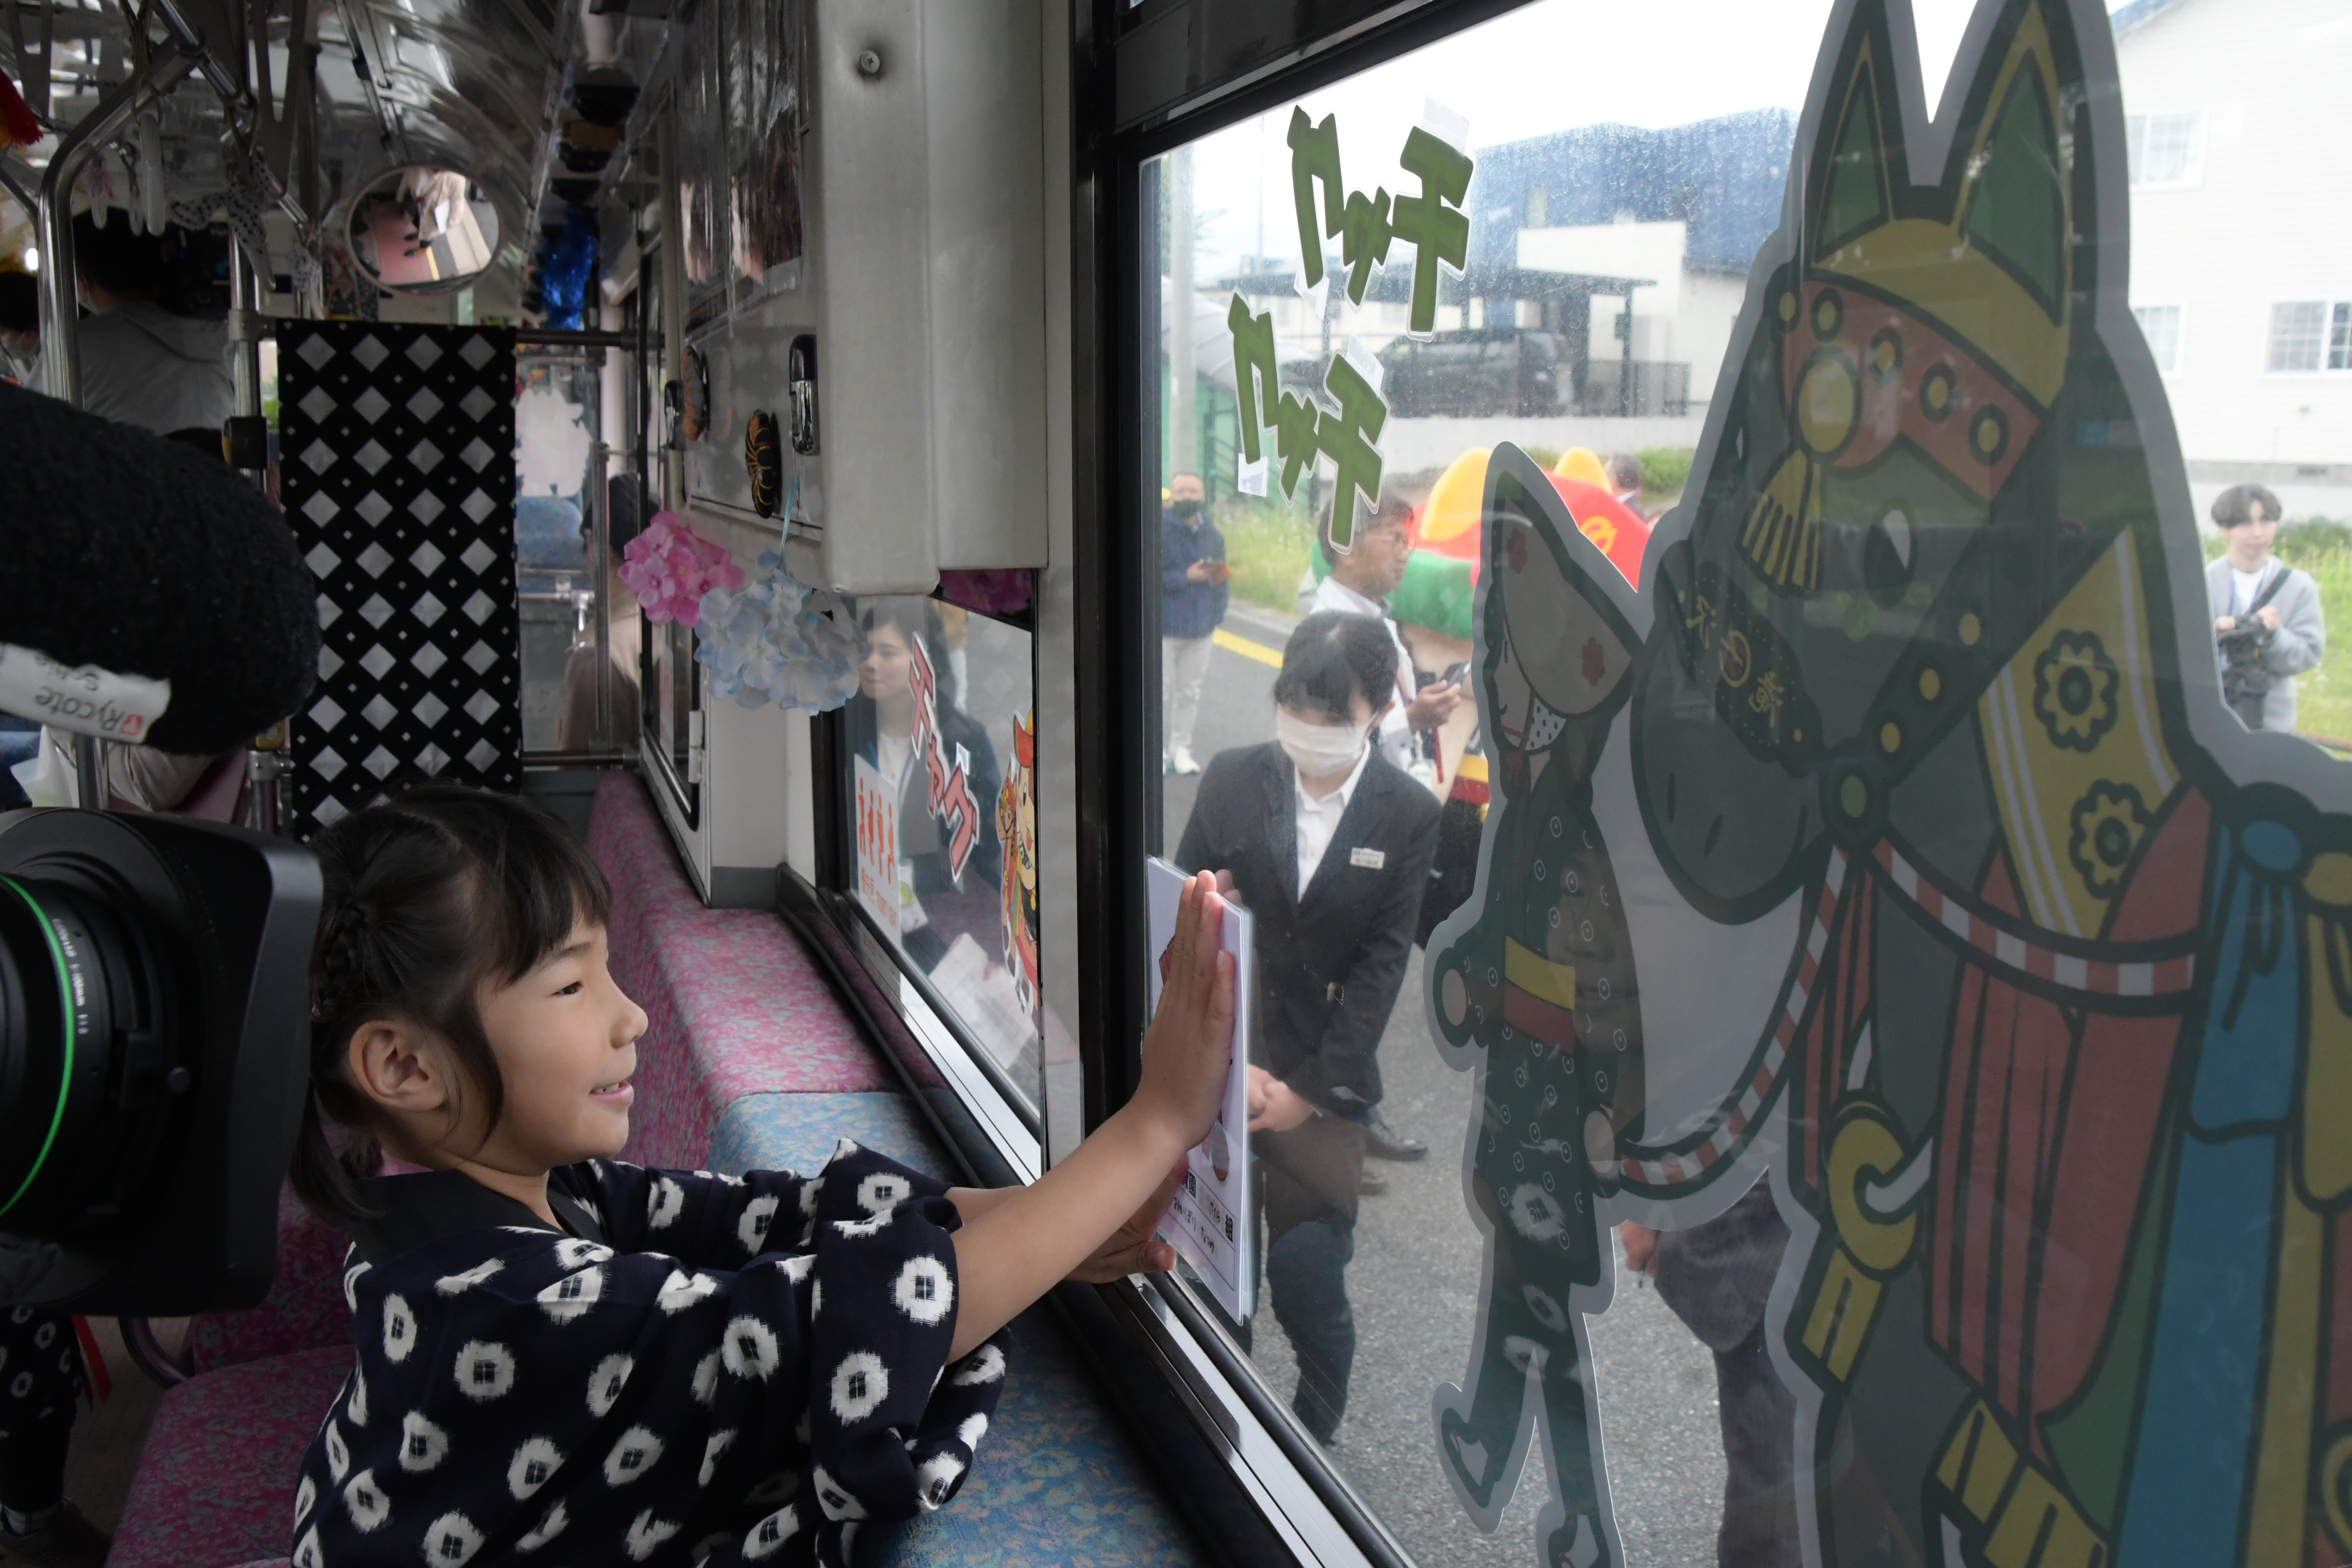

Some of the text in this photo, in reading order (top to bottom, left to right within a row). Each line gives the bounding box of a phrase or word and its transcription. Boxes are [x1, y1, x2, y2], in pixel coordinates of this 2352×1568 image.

[35, 685, 125, 731] Rycote
[909, 636, 977, 877] チャグ
[1225, 1214, 1233, 1242] 組
